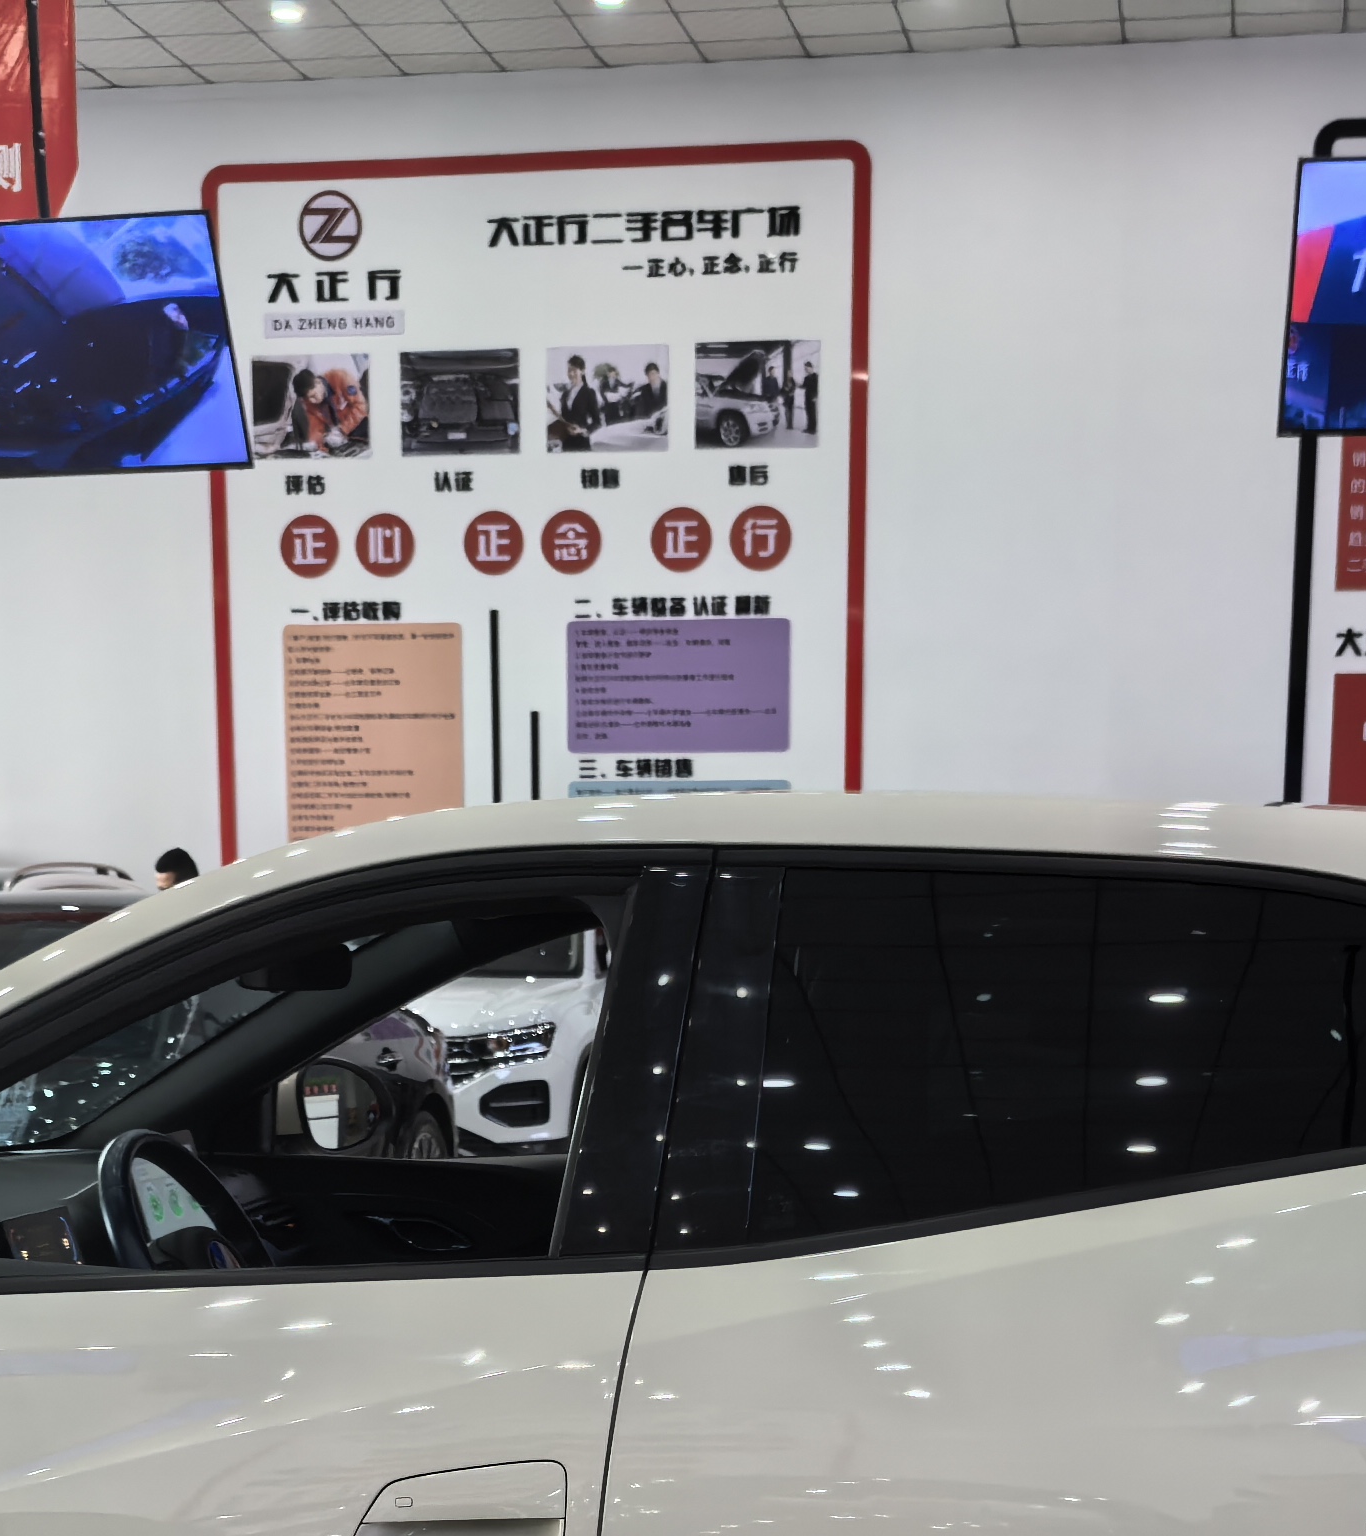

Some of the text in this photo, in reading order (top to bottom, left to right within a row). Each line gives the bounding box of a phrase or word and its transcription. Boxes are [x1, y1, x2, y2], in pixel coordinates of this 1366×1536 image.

[487, 206, 801, 248] 大正行二手名车广场
[266, 269, 401, 304] 大正行
[273, 318, 293, 332] DA
[354, 315, 396, 329] HANG
[285, 475, 327, 496] 评估
[435, 471, 474, 493] 认证
